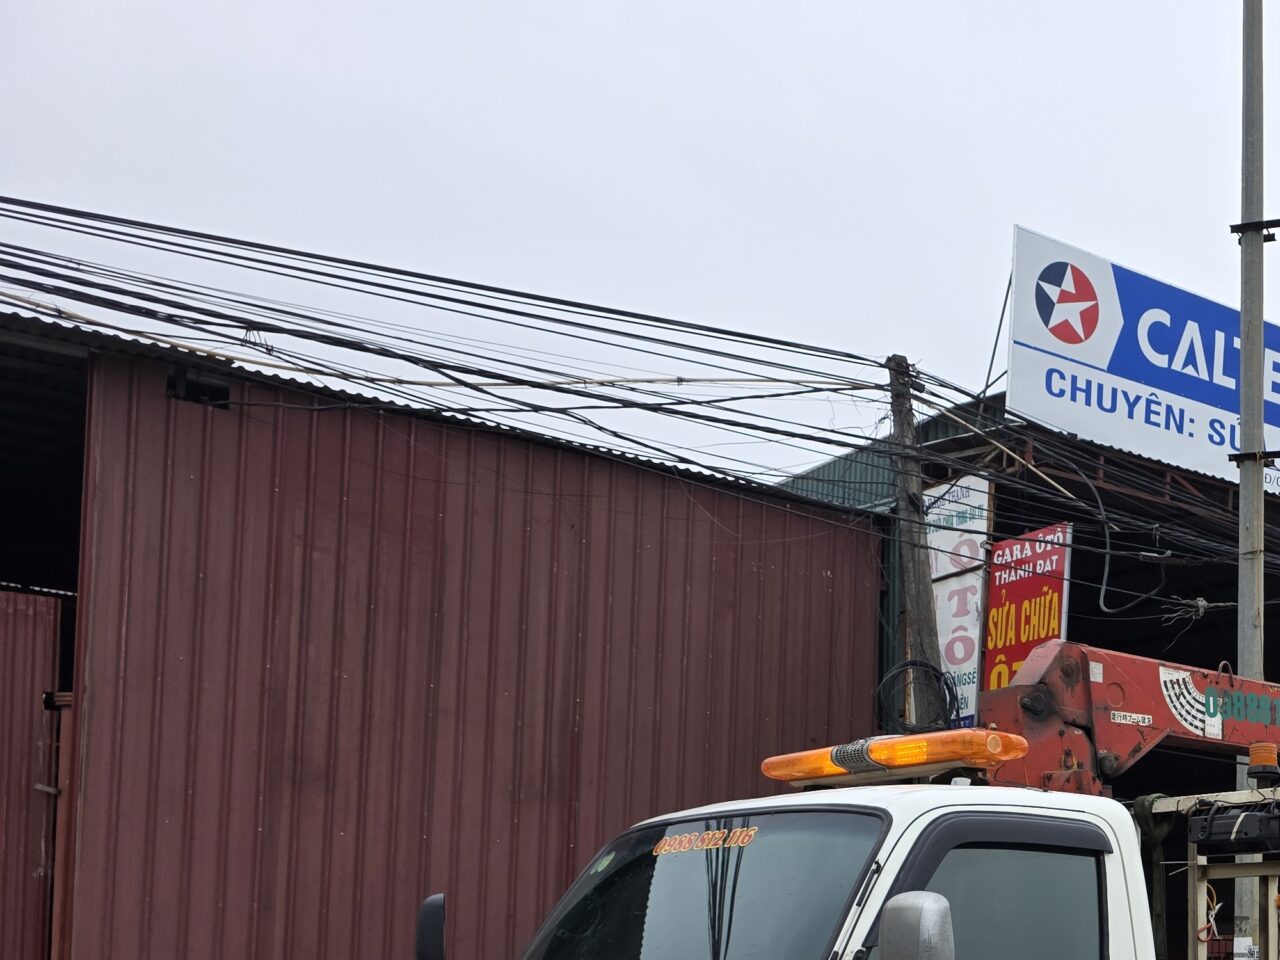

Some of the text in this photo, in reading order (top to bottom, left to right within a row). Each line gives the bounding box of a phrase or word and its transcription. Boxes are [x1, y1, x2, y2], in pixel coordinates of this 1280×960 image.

[1045, 367, 1195, 438] CHUYÊN:
[993, 528, 1064, 564] GARA ÔTÔ
[995, 555, 1059, 586] THÀNH ĐẠT
[988, 585, 1059, 650] SỬA CHỮA
[653, 826, 759, 856] 0988 812 116
